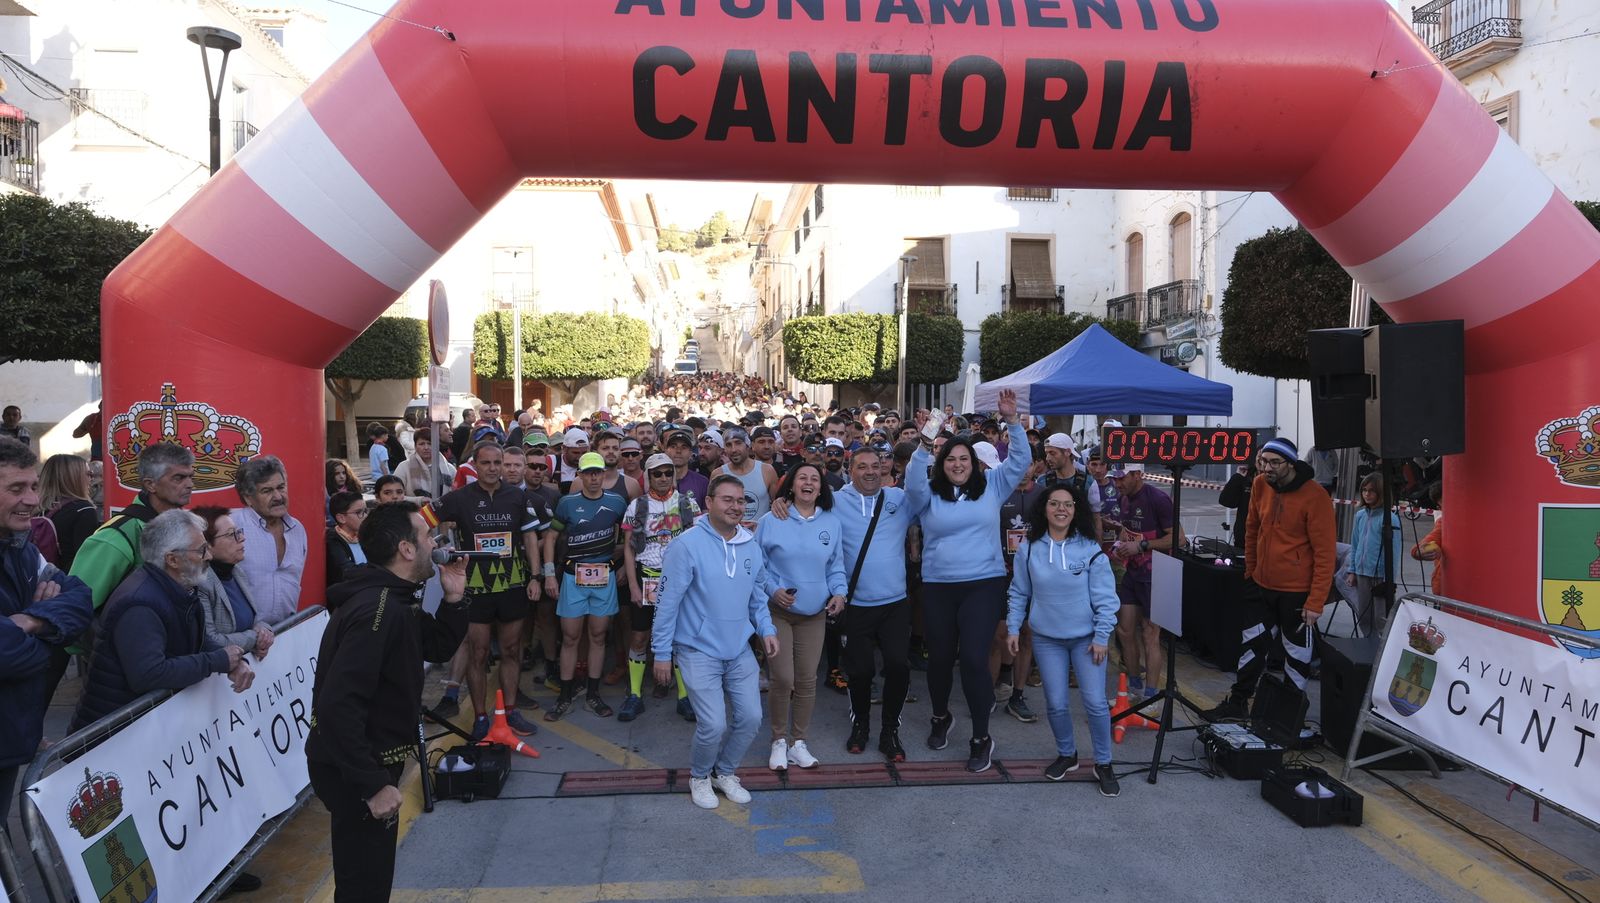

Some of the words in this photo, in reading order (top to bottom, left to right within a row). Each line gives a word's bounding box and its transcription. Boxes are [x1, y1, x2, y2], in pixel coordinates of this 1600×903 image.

[632, 45, 1193, 152] CANTORIA
[481, 538, 506, 548] 208
[585, 568, 600, 577] 31
[1447, 680, 1596, 768] CANT
